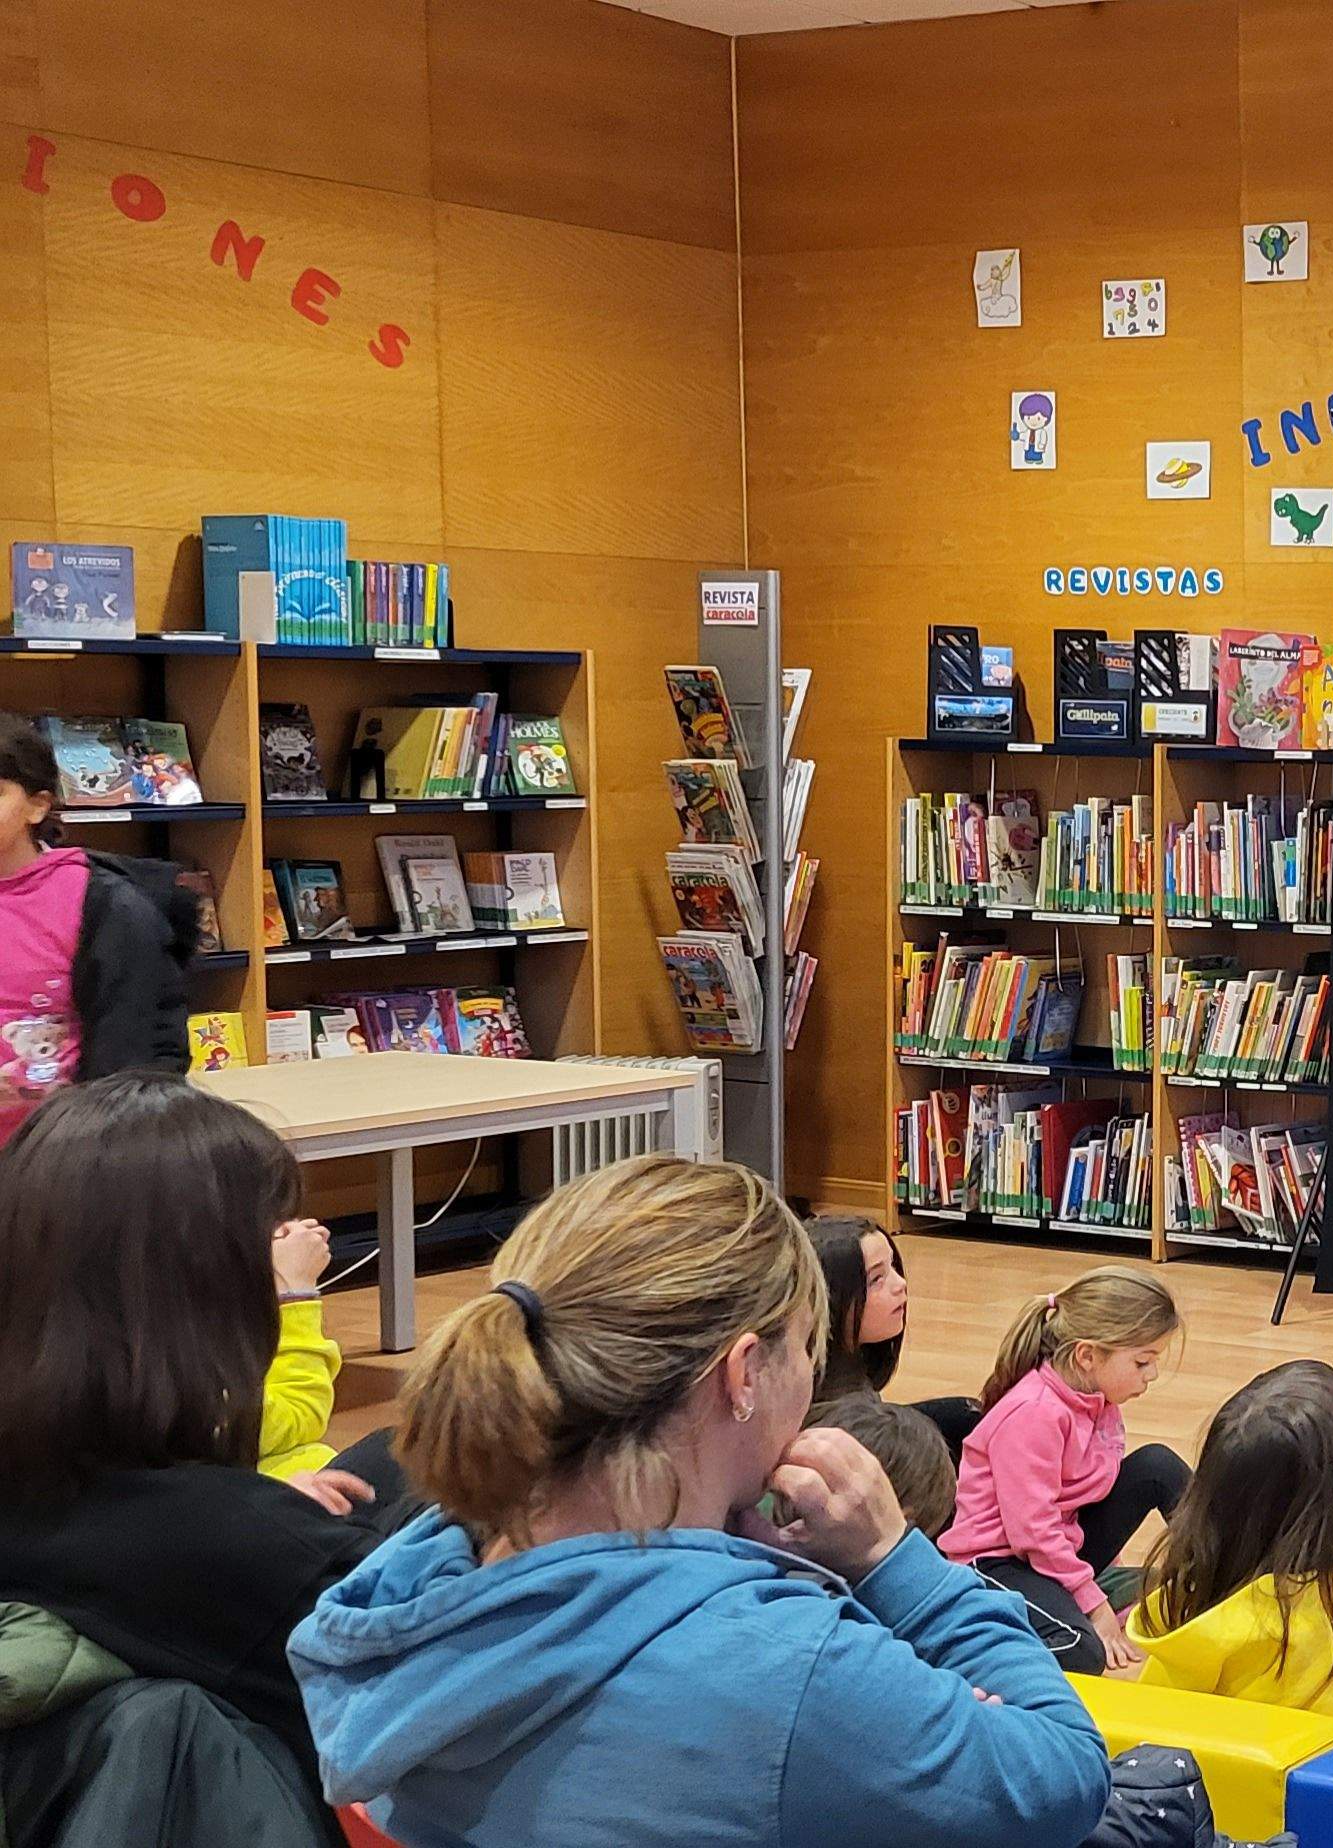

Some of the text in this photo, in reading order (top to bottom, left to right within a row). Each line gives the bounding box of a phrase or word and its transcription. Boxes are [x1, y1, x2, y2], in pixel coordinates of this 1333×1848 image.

[20, 135, 411, 369] IONES
[1043, 566, 1225, 597] REVISTAS
[704, 590, 755, 605] REVISTA
[705, 607, 755, 621] caracola
[663, 944, 718, 960] caracola
